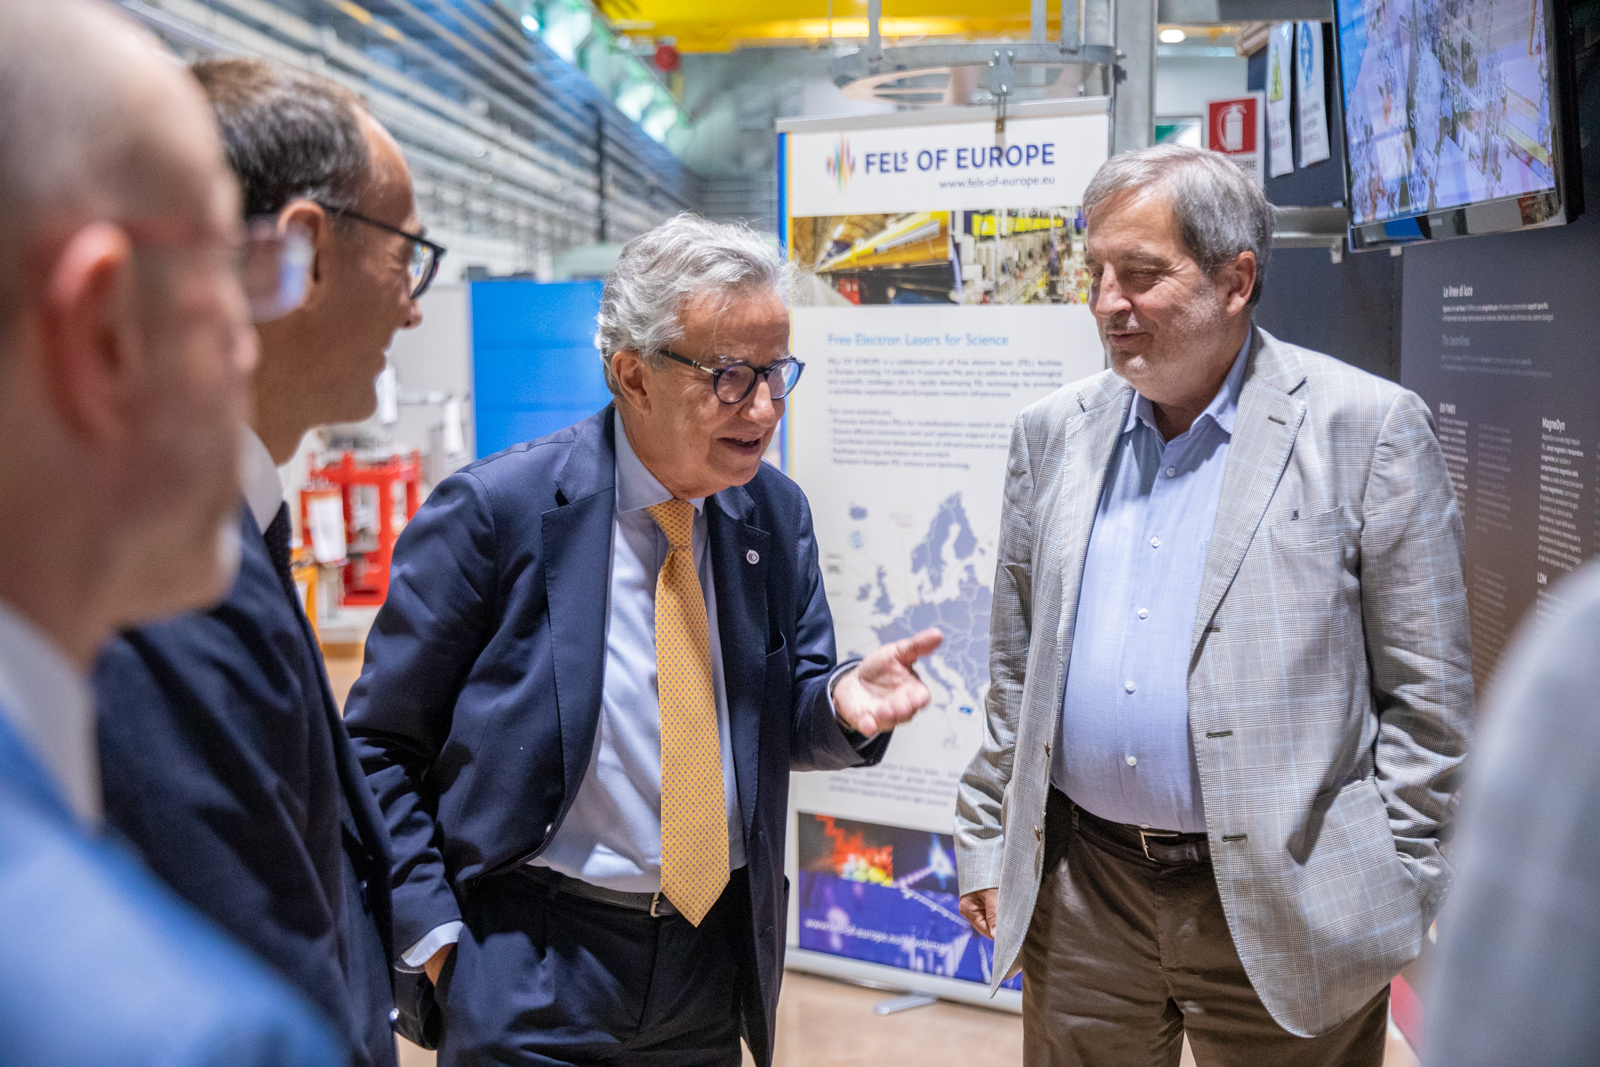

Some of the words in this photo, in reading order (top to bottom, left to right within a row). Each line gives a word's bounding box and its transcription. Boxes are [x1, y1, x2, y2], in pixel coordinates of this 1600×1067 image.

[917, 149, 948, 171] OF
[956, 143, 1055, 169] EUROPE
[939, 176, 1055, 190] www.fels-of-europe.eu
[828, 334, 851, 347] Free
[856, 334, 902, 347] Electron
[905, 334, 941, 347] Lasers
[945, 334, 961, 347] for
[966, 334, 1010, 347] Science
